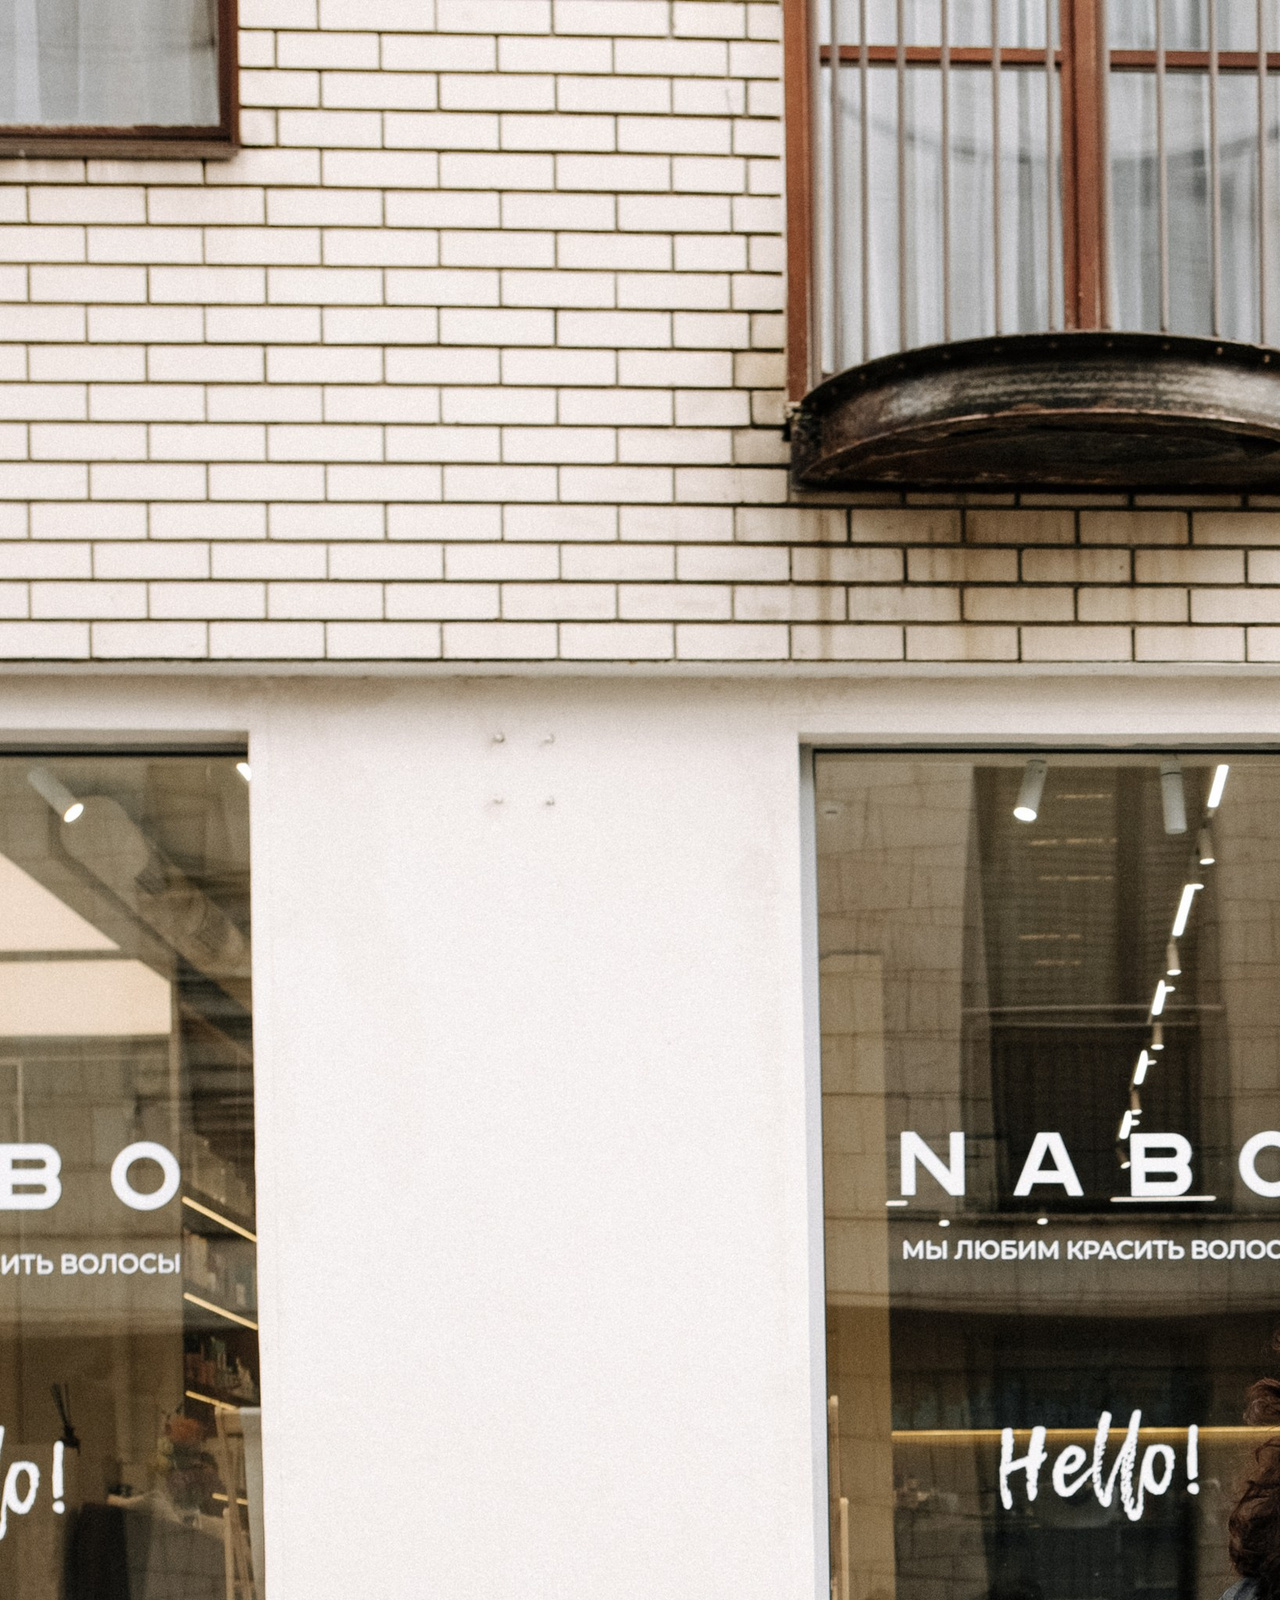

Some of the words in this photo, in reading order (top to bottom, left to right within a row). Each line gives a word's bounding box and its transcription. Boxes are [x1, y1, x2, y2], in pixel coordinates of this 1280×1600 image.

[902, 1239, 948, 1260] МЫ
[953, 1239, 1060, 1260] ЛЮБИМ
[1066, 1239, 1186, 1260] КРАСИТЬ
[60, 1252, 181, 1275] ВОЛОСЫ
[998, 1408, 1200, 1522] Hello!
